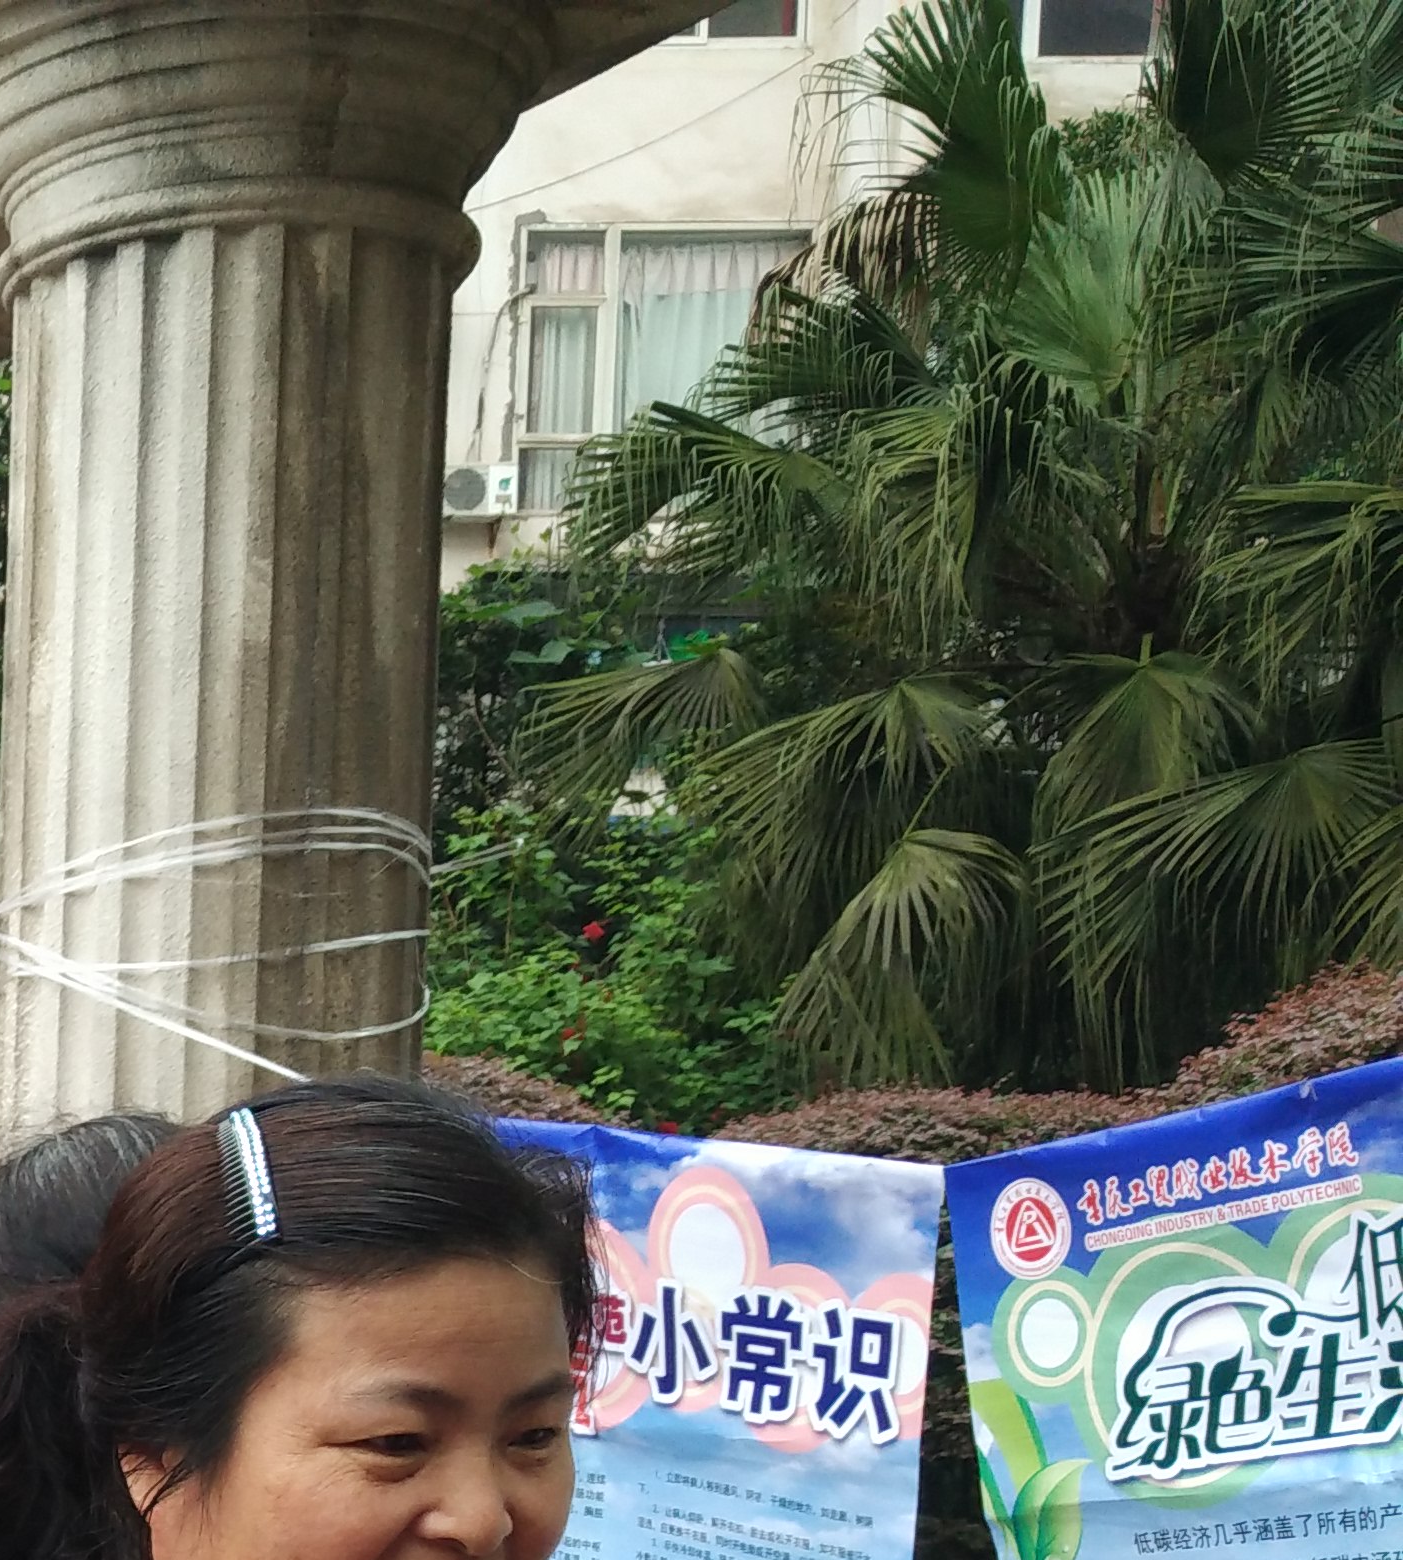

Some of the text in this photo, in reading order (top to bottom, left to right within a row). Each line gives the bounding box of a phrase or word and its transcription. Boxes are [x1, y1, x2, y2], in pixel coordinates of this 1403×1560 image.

[1086, 1178, 1361, 1249] CHONGQING INDUSTRY & TRADE POLYTECHNIC
[1112, 1325, 1403, 1470] 绿色生
[1133, 1503, 1403, 1555] 低碳经济几乎涵盖了所有的产
